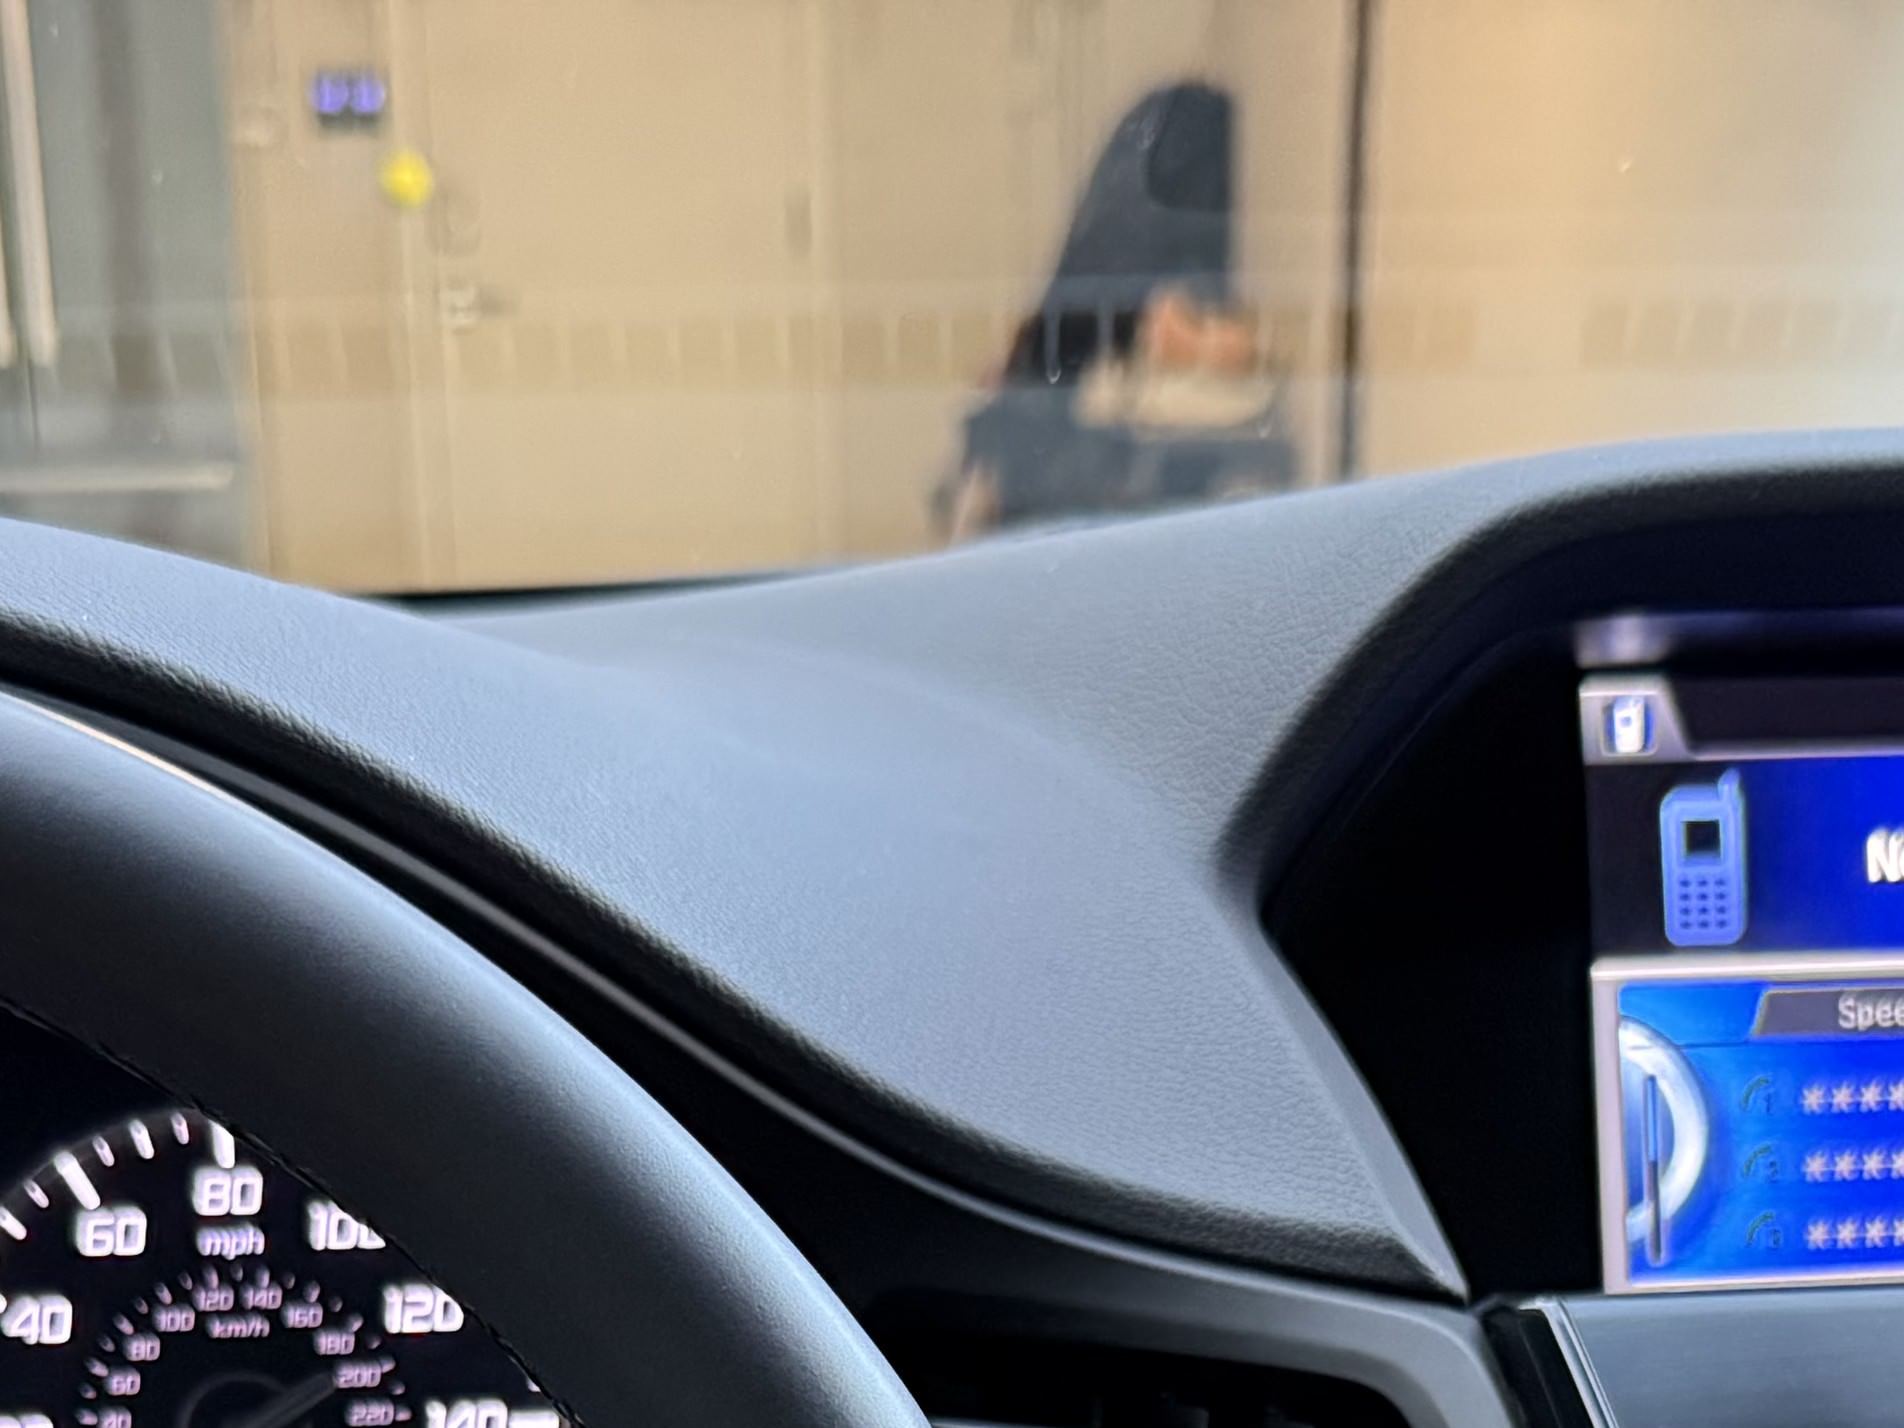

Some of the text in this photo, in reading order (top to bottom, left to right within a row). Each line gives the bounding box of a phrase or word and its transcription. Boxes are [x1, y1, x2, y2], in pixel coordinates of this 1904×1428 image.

[192, 1164, 265, 1218] 80
[75, 1204, 148, 1258] 60
[196, 1223, 266, 1260] mph
[194, 1281, 235, 1312] 120
[240, 1279, 284, 1311] 140
[382, 1281, 465, 1335] 120
[0, 1292, 73, 1346] 40
[151, 1302, 196, 1332] 100
[204, 1312, 272, 1340] km/h
[280, 1300, 324, 1329] 160
[122, 1331, 162, 1362] 80
[313, 1326, 356, 1356] 180
[105, 1366, 142, 1396] 60
[335, 1358, 383, 1390] 200
[344, 1400, 395, 1428] 220
